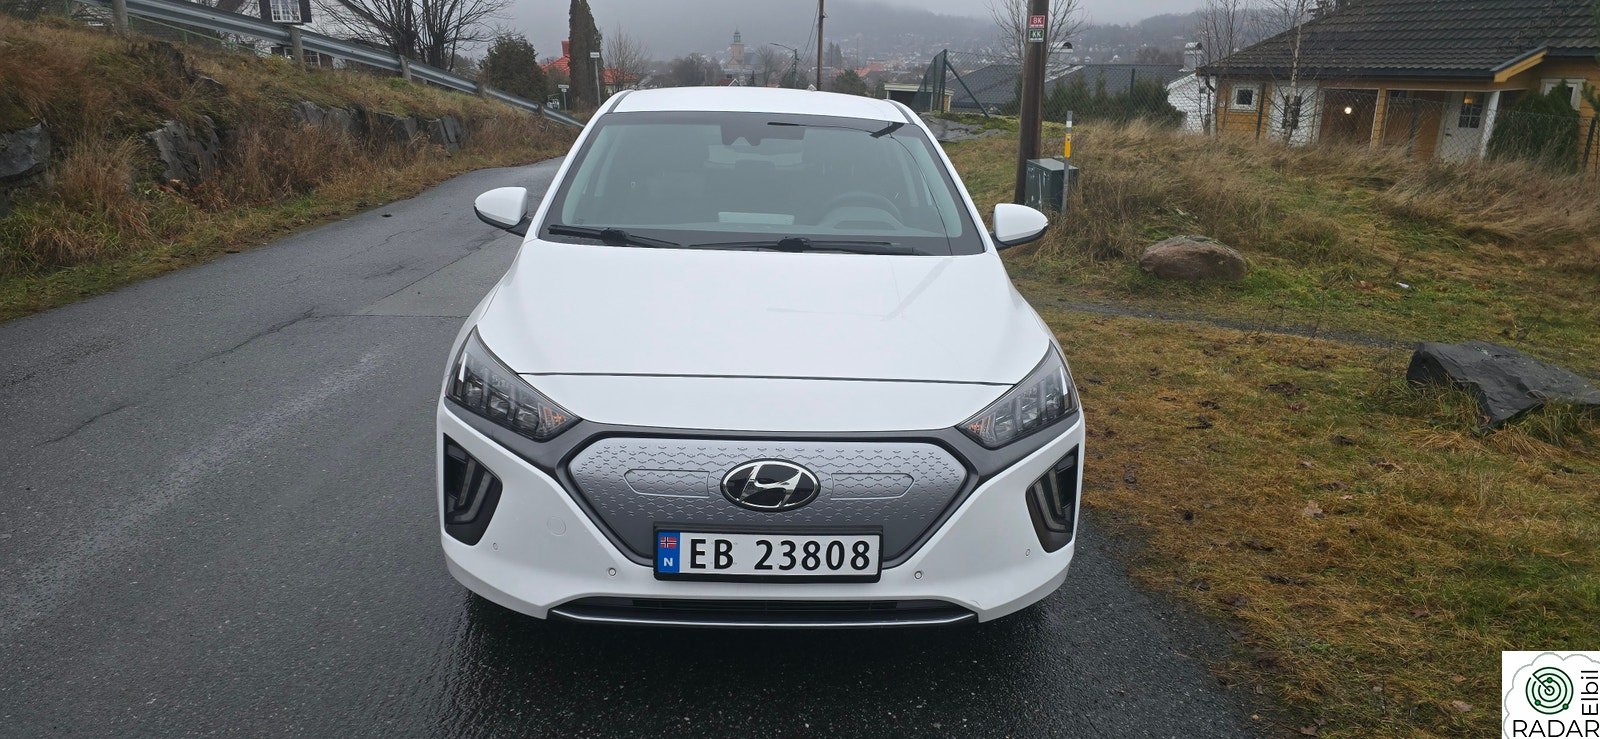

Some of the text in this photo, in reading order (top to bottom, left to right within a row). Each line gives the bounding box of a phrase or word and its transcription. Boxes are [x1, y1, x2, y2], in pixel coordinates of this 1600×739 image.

[663, 557, 673, 567] N
[690, 538, 870, 571] EB 23808
